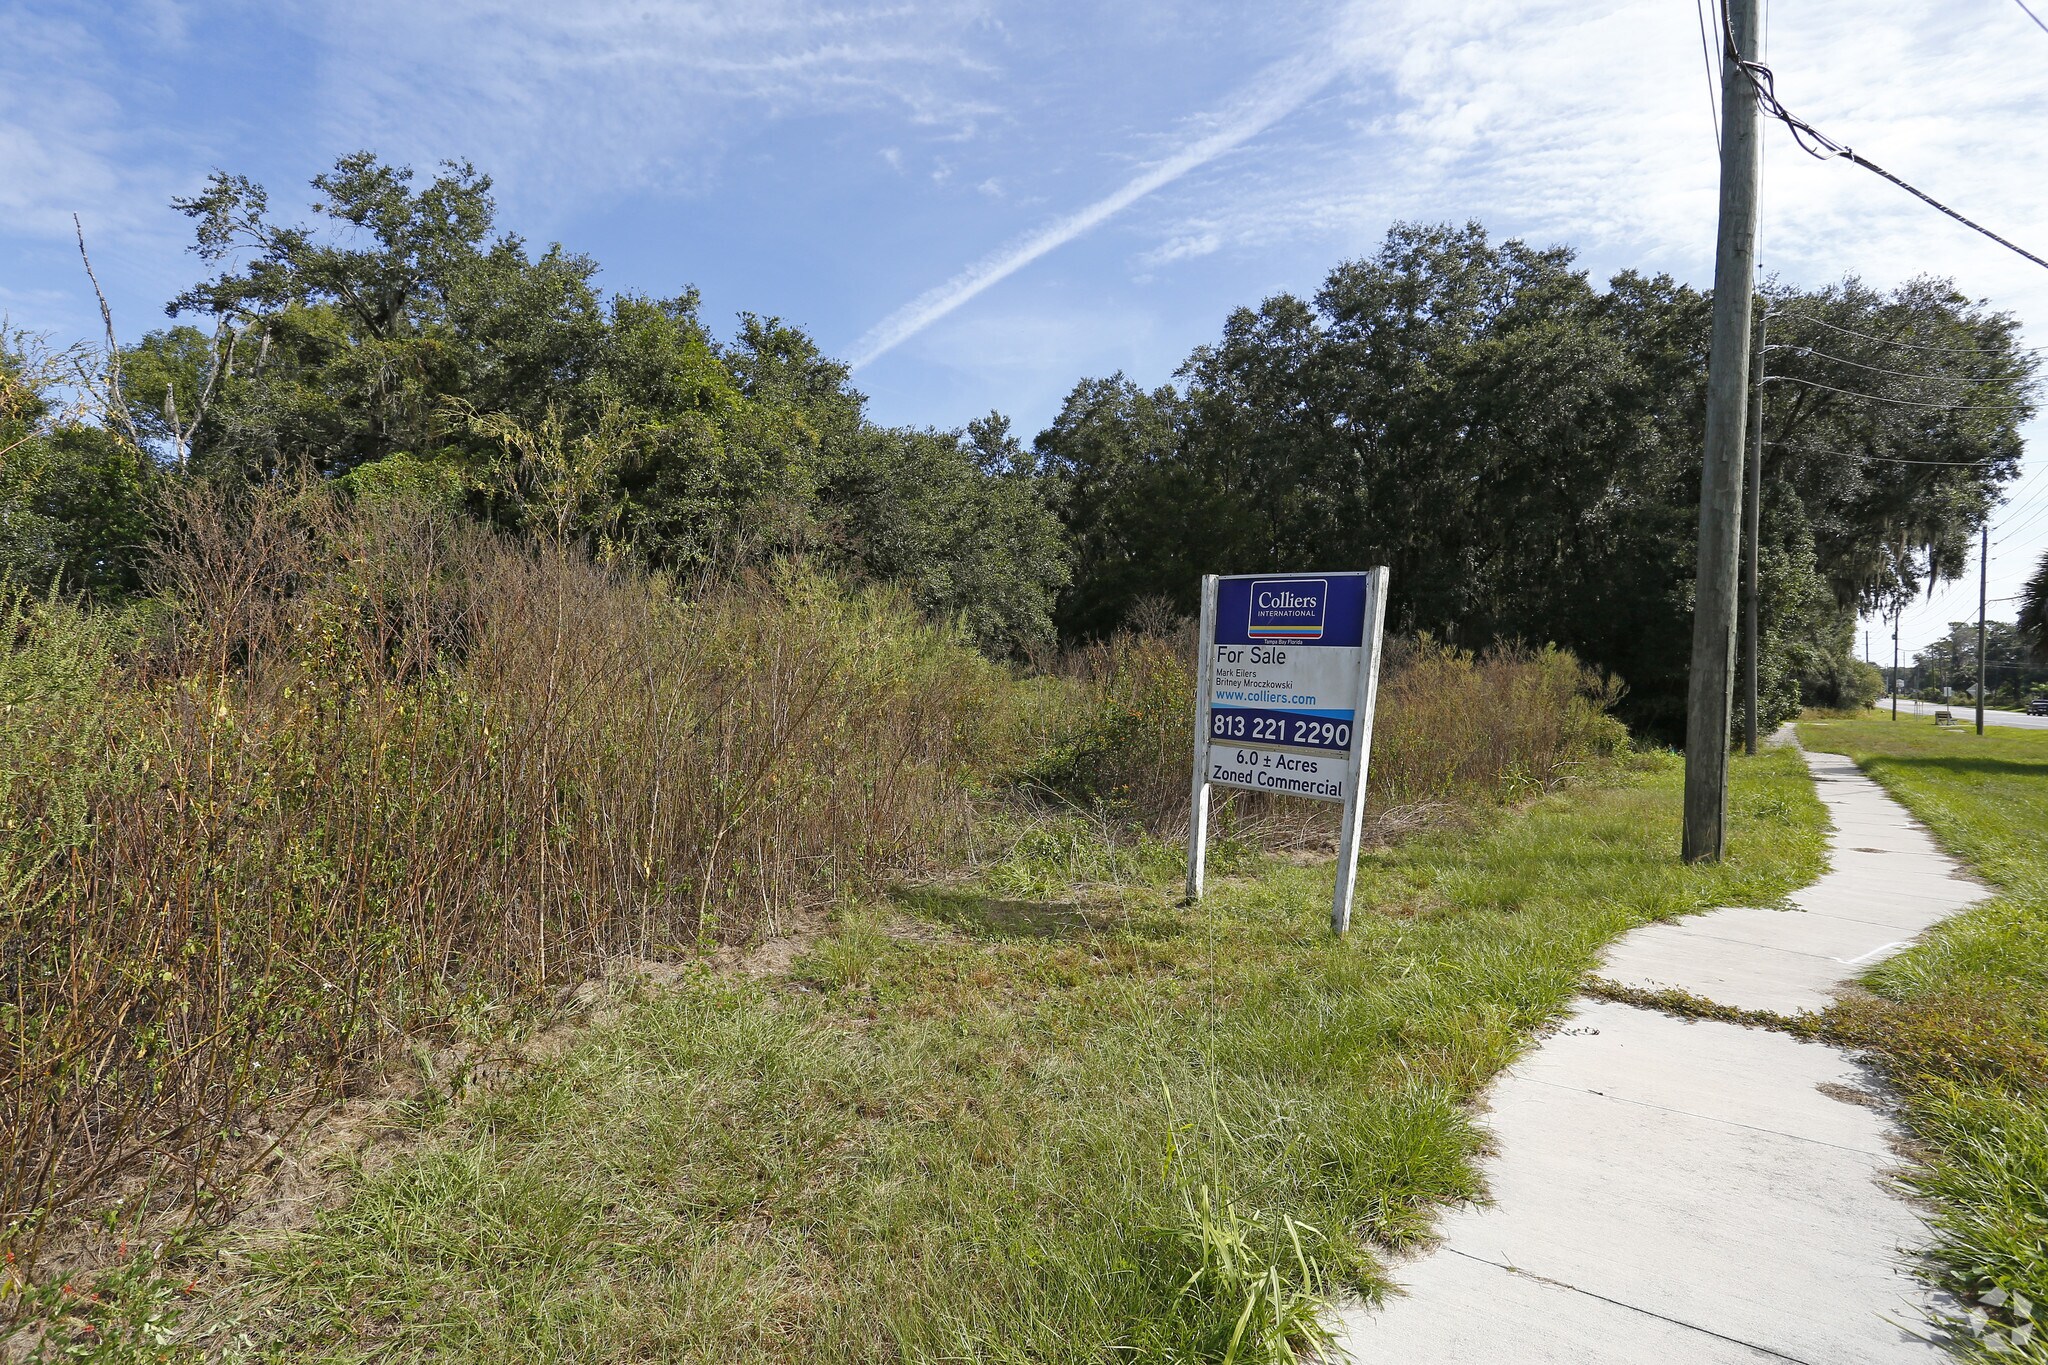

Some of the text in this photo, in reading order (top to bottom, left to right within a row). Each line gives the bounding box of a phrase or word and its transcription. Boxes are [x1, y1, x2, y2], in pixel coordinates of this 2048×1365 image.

[1258, 591, 1317, 609] Colliers
[1217, 646, 1286, 665] For Sale
[1216, 668, 1257, 678] Mark Eilers
[1216, 678, 1293, 689] Britney Mroczkowski
[1216, 690, 1316, 705] www.colliers.com
[1213, 714, 1350, 747] 813 221 2290
[1236, 750, 1258, 764] 6.0
[1275, 754, 1318, 773] Acres
[1212, 764, 1342, 797] Zoned Commercial
